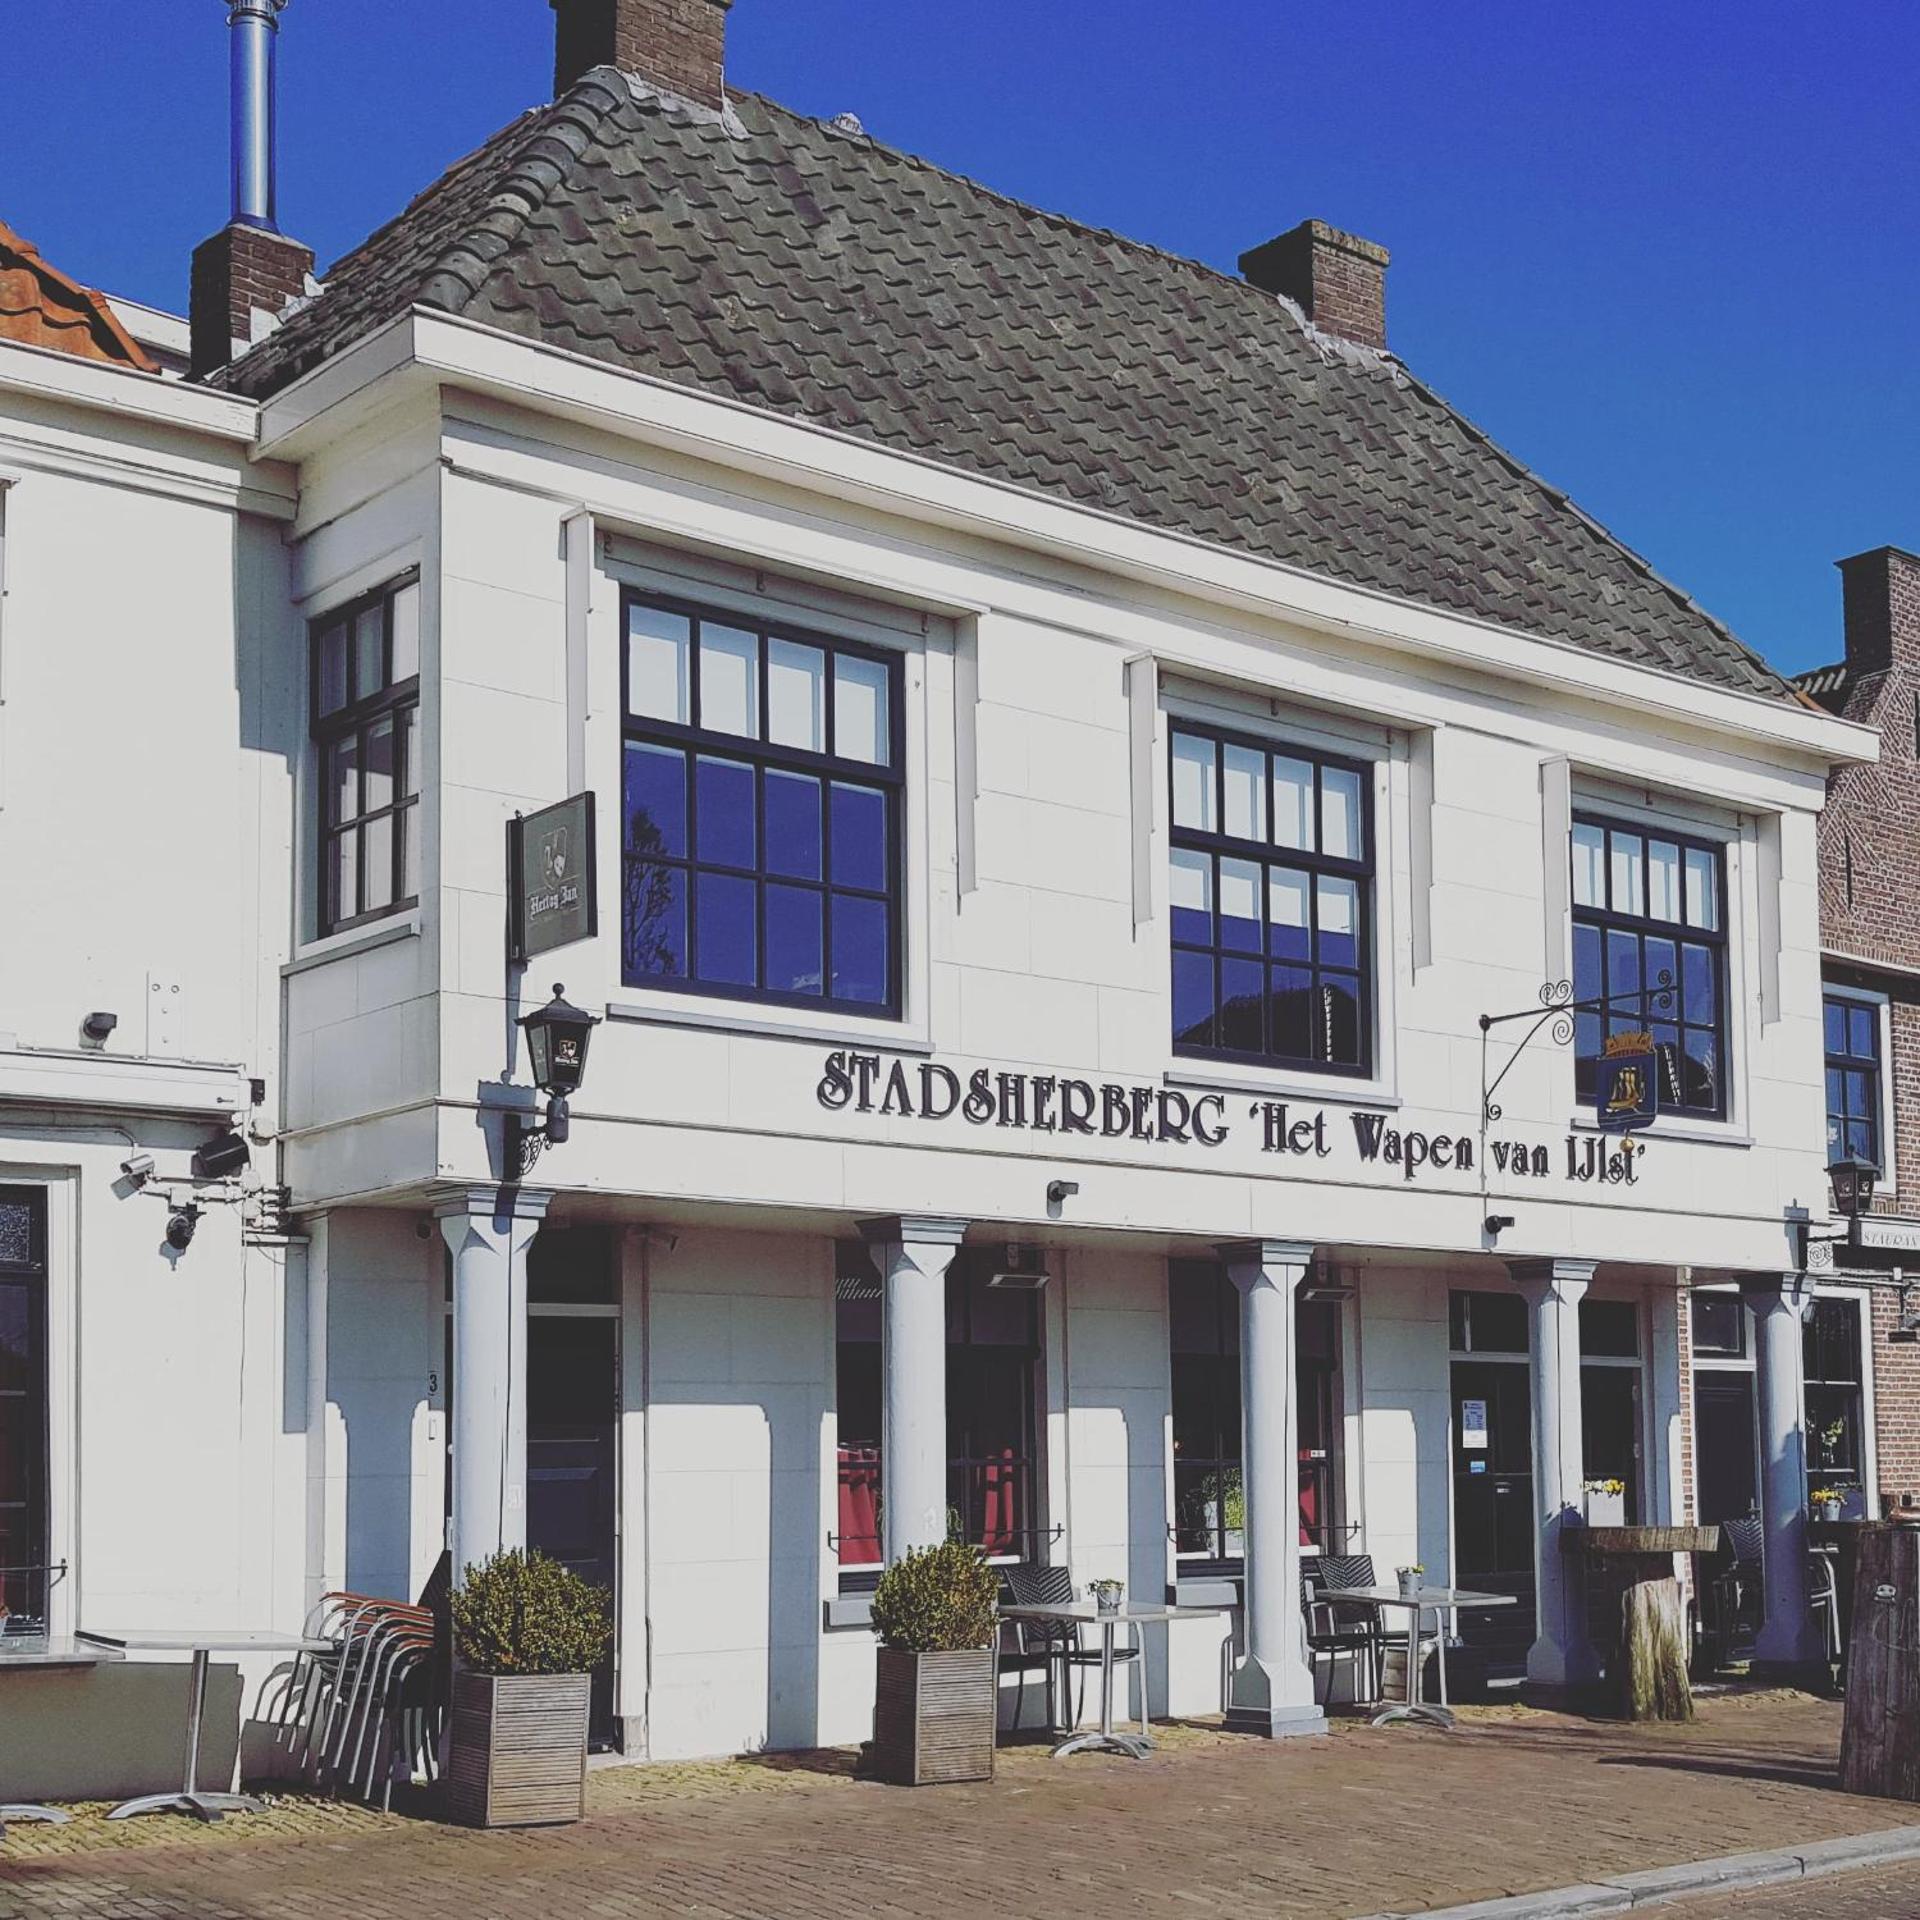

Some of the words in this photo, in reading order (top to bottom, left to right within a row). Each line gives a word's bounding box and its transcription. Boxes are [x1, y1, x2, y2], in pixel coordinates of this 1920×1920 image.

[816, 1050, 1231, 1148] STADSHERBERG
[1350, 1111, 1475, 1182] Wapen
[1489, 1140, 1551, 1178] van
